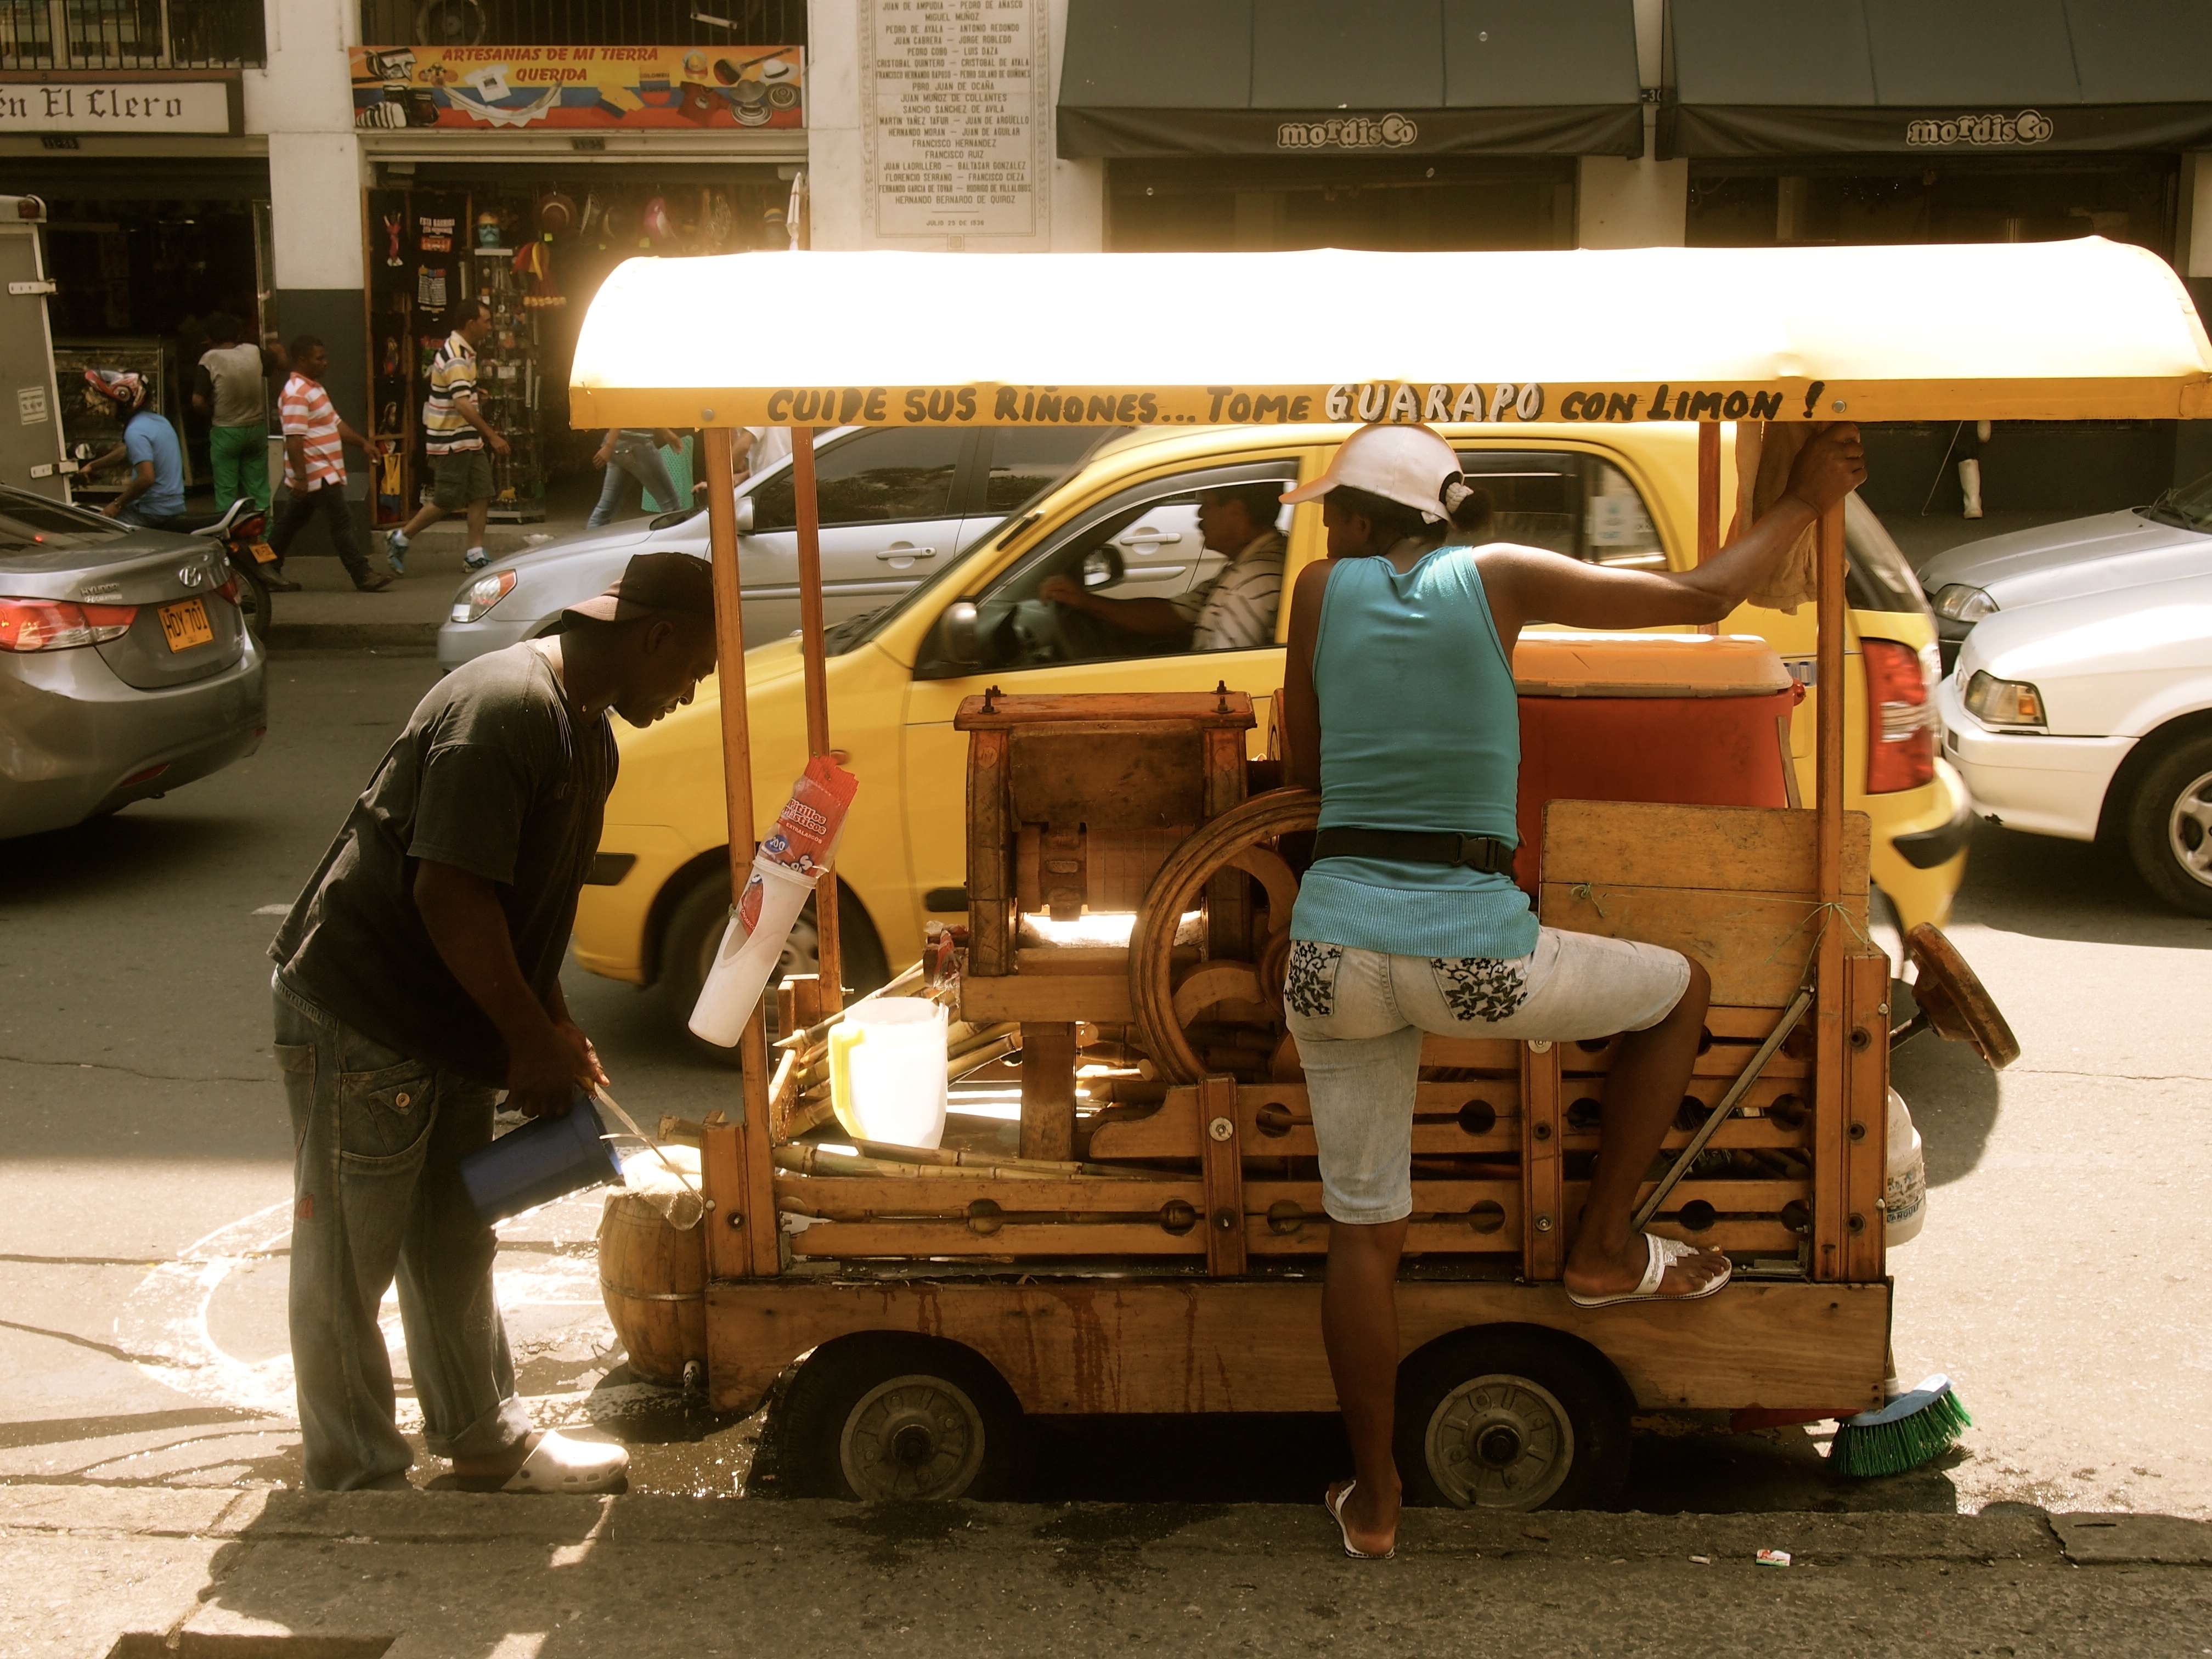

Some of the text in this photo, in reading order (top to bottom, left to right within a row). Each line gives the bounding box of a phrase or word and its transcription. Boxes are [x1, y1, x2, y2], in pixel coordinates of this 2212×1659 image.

[883, 2, 899, 10] JUAN
[916, 2, 943, 10] AMPUDIA
[956, 11, 979, 21] MUÑOZ
[914, 36, 941, 44] CABRERA
[443, 48, 658, 61] ARTESANIAS DE MI TIERRA
[877, 59, 910, 67] CRISTOBAL
[516, 68, 588, 82] QUERIDA
[960, 70, 975, 78] PEDRO
[935, 82, 953, 91] JUAN
[958, 82, 966, 91] DE
[972, 81, 994, 90] OCAÑA
[923, 93, 946, 102] MUÑOZ
[41, 88, 74, 118] El
[86, 88, 182, 119] Clero
[903, 105, 930, 114] SANCHO
[879, 117, 902, 125] MARTIN
[907, 115, 925, 125] YAÑEZ
[930, 116, 949, 125] TAFUR
[966, 116, 981, 125] JUAN
[1278, 114, 1416, 147] mordisco
[1908, 111, 2052, 144] mordisco
[912, 139, 950, 148] FRANCISCO
[926, 151, 963, 159] FRANCISCO
[884, 162, 899, 171] JUAN
[958, 162, 989, 170] BALTASAR
[885, 173, 919, 182] FLORENCIO
[908, 185, 926, 193] GARCIA
[978, 195, 985, 204] DE
[904, 387, 977, 423] SUS
[1207, 386, 1312, 423] TOME
[1325, 383, 1544, 422] GUARAPO
[1560, 391, 1637, 421] CON
[1647, 384, 1783, 420] LIMON
[163, 606, 207, 639] HDY 701
[787, 798, 827, 825] Pitillos
[782, 805, 827, 836] Plásticos
[786, 823, 822, 844] EXTRALARGOS
